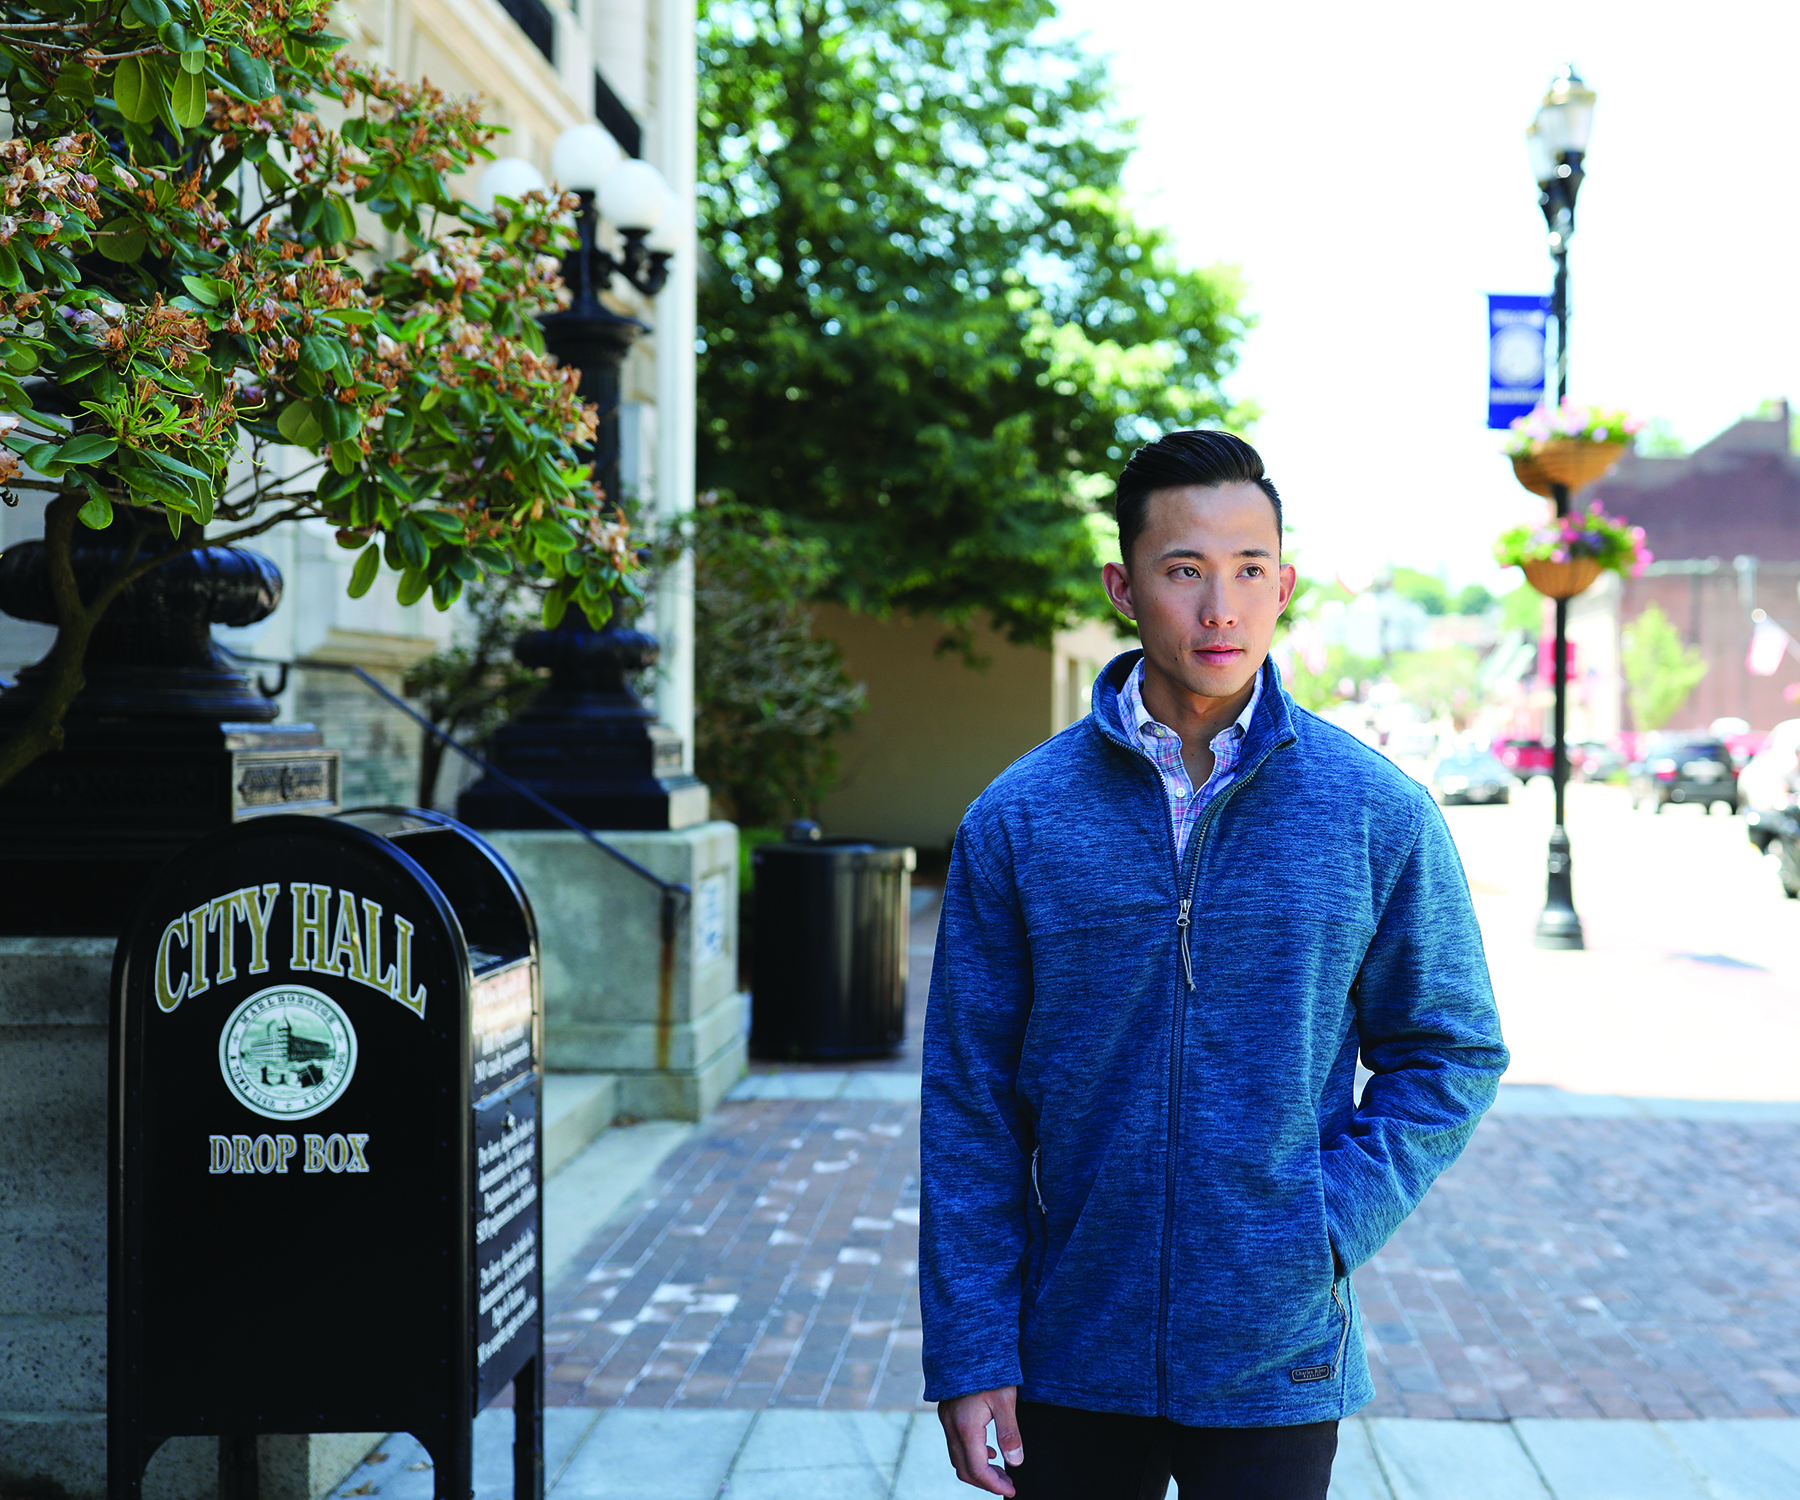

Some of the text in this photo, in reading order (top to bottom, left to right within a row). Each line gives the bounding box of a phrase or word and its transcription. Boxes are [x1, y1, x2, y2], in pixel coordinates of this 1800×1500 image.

[154, 882, 427, 1020] CITY HALL
[208, 1133, 370, 1174] DROP BOX
